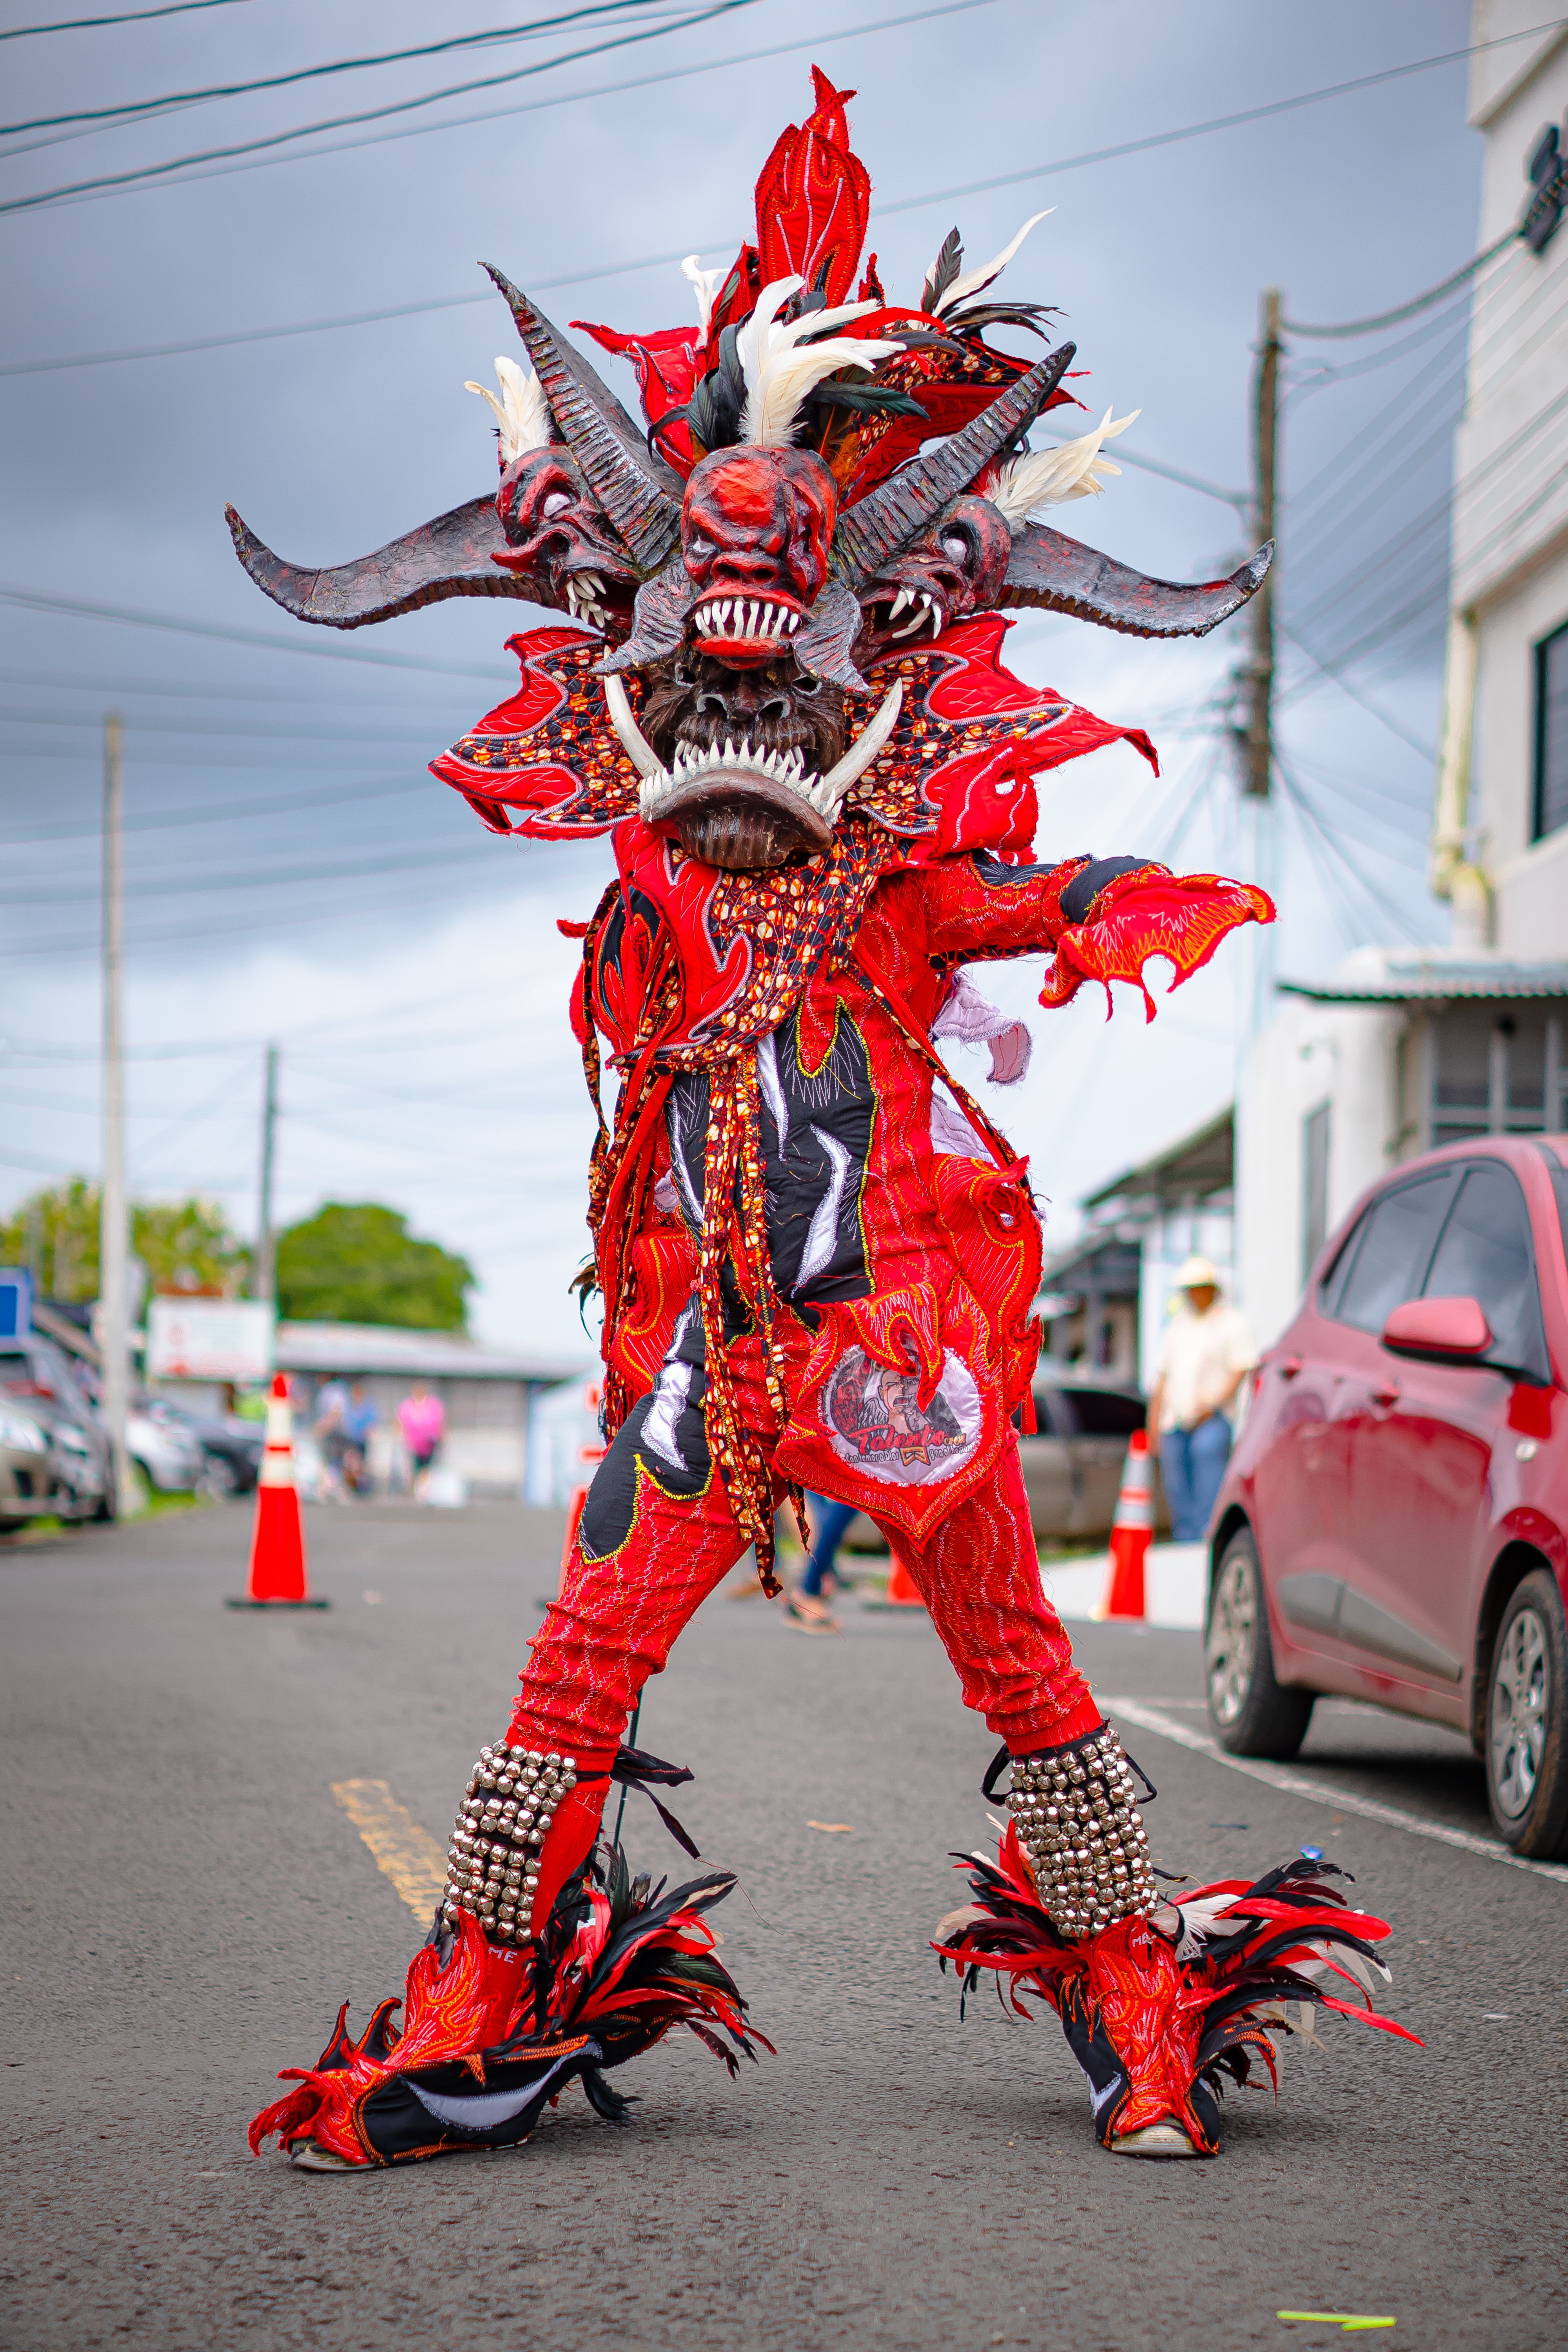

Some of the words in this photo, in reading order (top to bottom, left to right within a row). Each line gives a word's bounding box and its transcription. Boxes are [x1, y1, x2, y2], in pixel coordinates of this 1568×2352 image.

[848, 1423, 946, 1455] Talento
[846, 1453, 859, 1463] Con
[858, 1453, 878, 1463] temor
[878, 1453, 885, 1463] a
[929, 1449, 935, 1461] y
[935, 1448, 944, 1458] no
